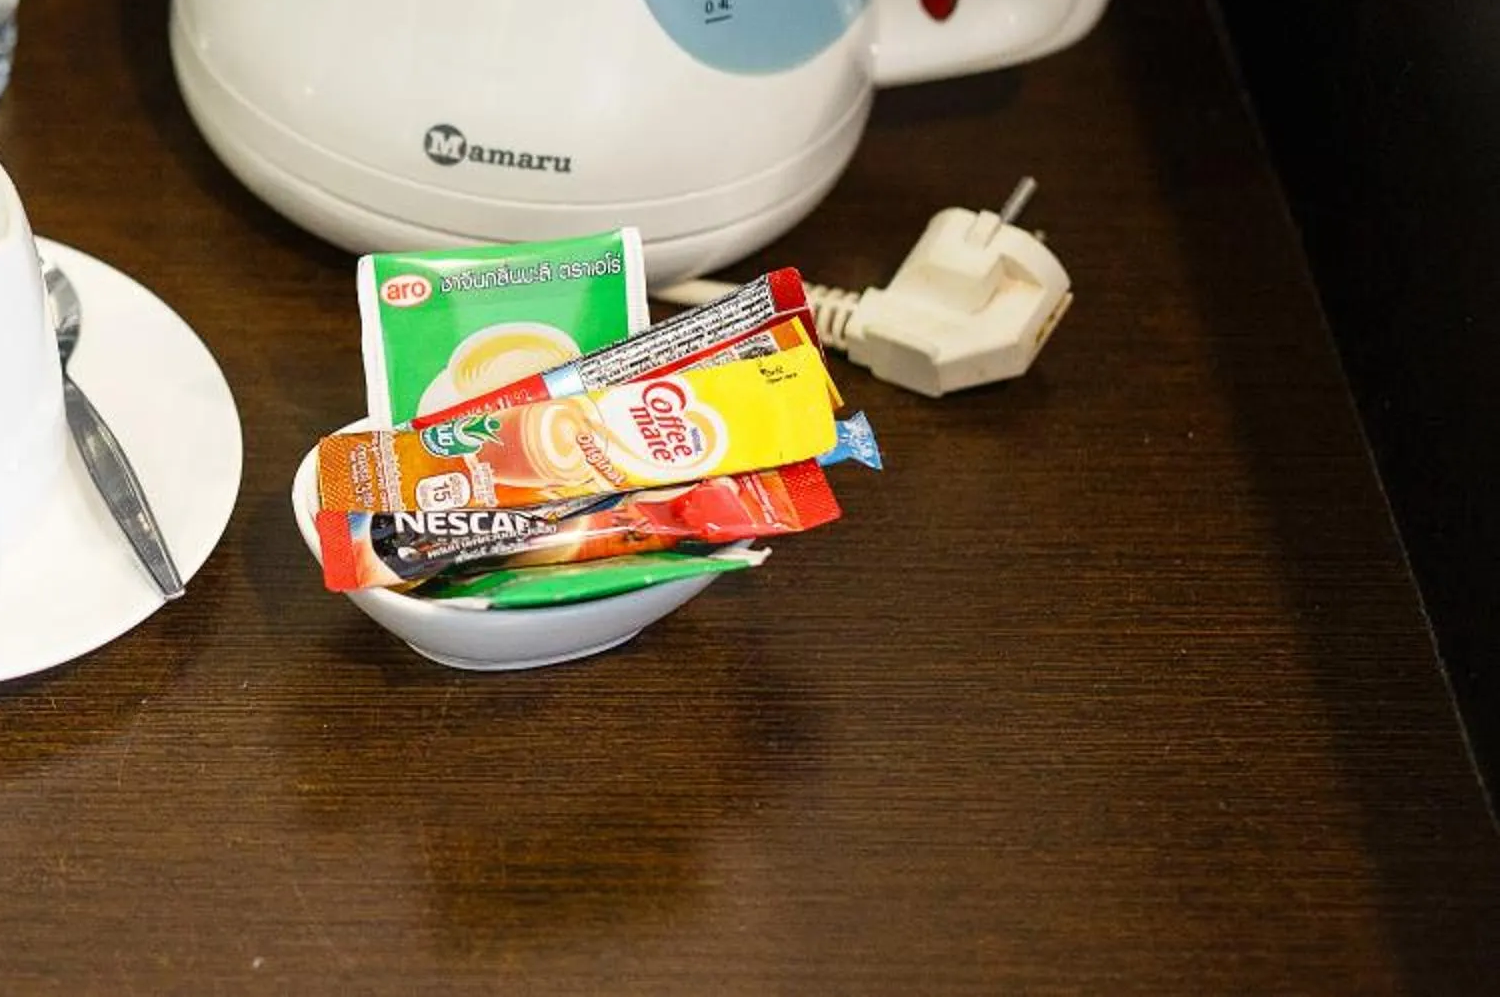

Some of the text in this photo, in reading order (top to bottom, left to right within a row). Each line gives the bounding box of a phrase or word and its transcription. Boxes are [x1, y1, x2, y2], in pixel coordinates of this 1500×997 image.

[423, 123, 573, 174] Mamaru
[386, 279, 427, 301] aro
[629, 405, 673, 463] mate
[641, 380, 693, 458] Coffee
